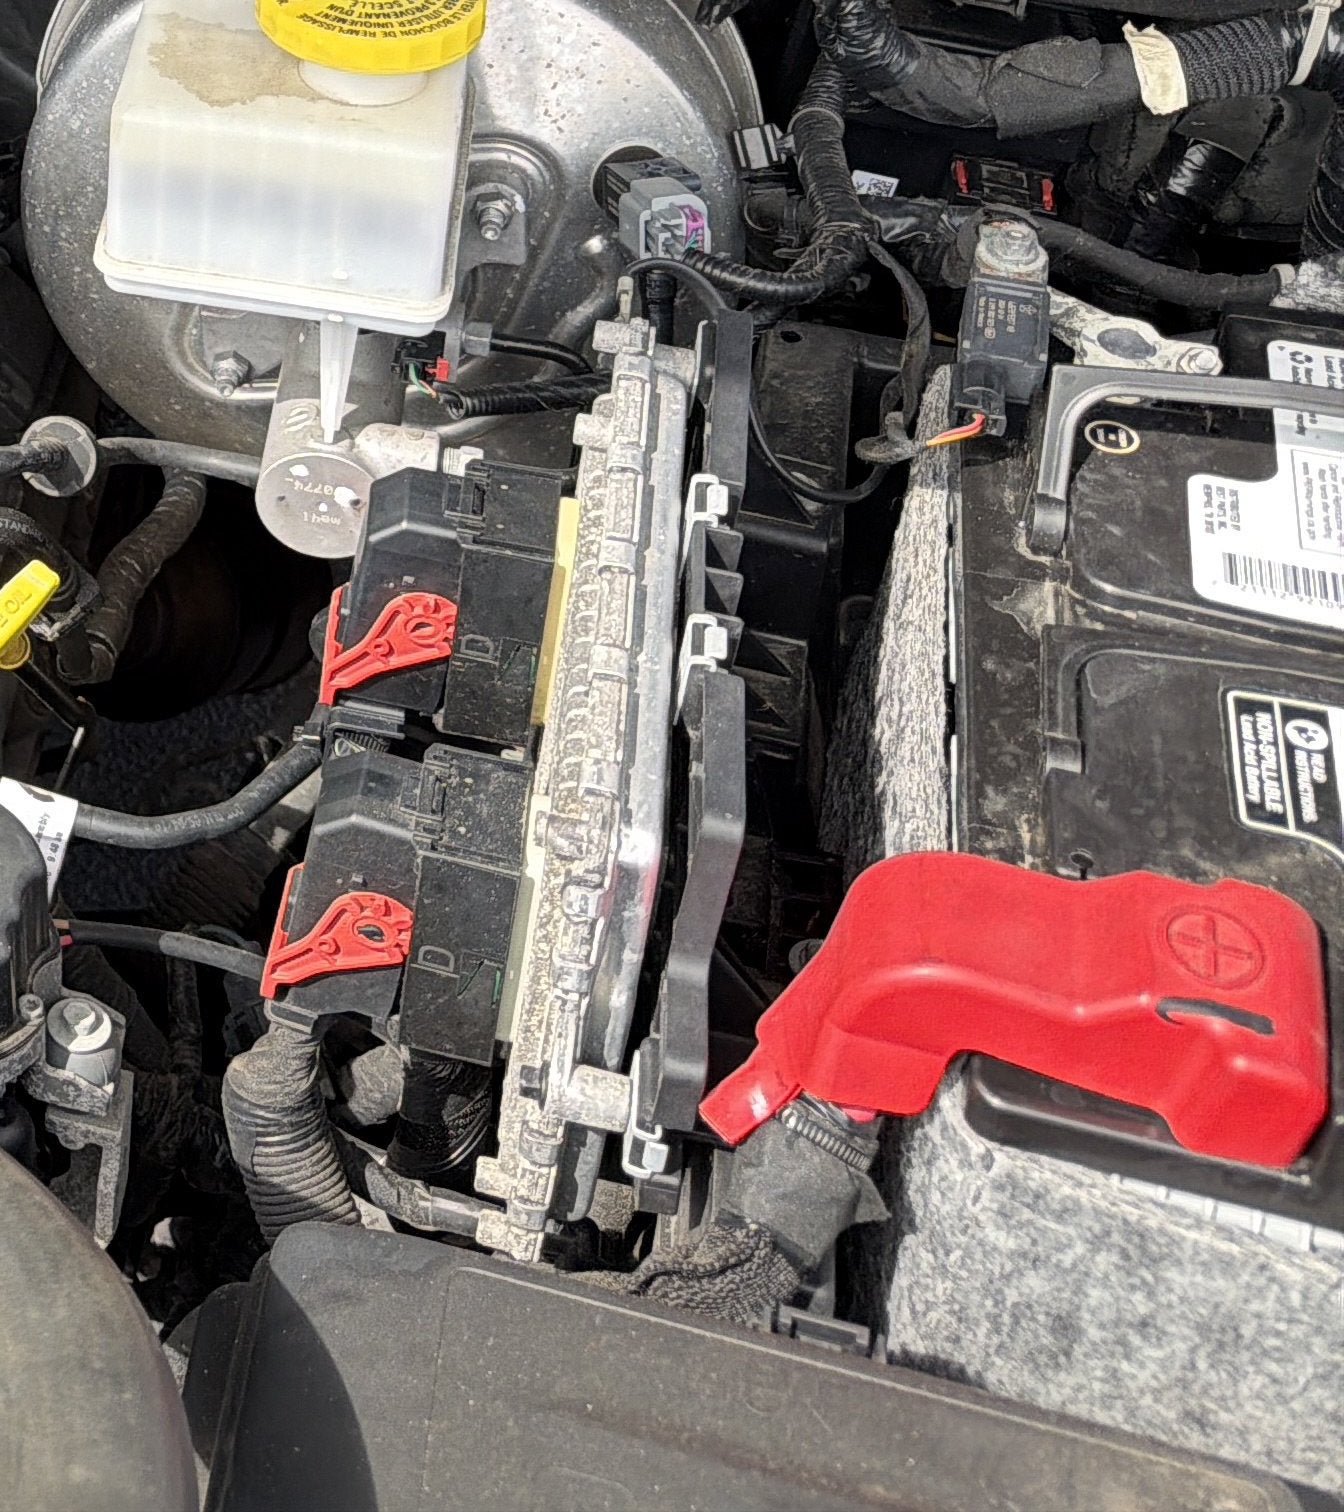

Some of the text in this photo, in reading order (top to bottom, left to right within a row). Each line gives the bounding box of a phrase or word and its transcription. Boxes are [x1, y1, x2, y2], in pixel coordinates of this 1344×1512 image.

[296, 13, 377, 38] REMPLISSAGE
[315, 11, 394, 28] UNIQUEMENT
[400, 17, 453, 36] BOUCHON
[4, 588, 33, 615] OIL
[1239, 713, 1261, 805] Lead Acid Battery
[1255, 710, 1284, 815] NON-SPILLABLE
[1310, 751, 1328, 784] READ
